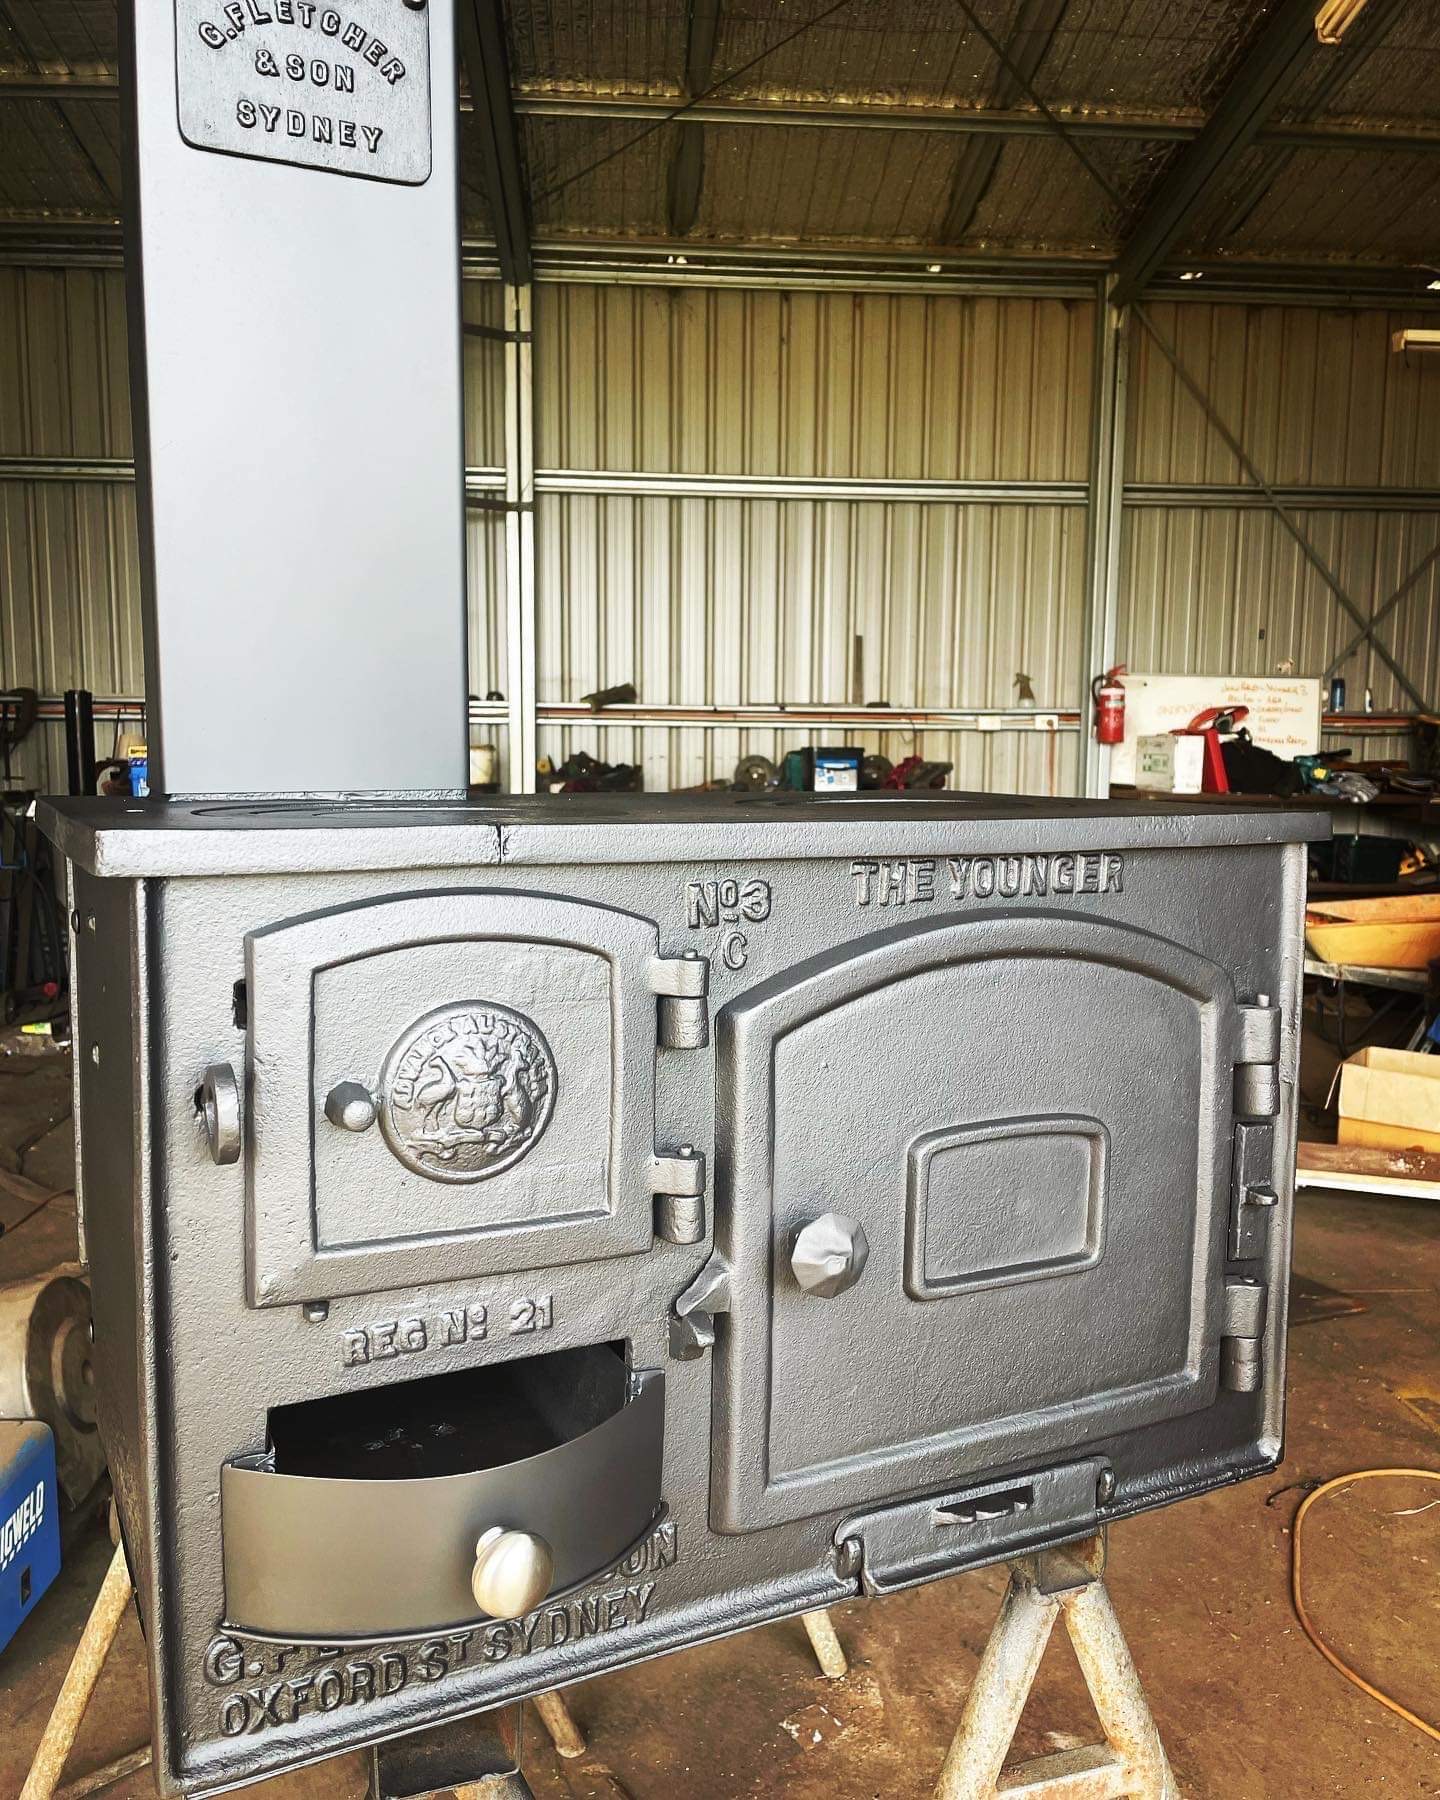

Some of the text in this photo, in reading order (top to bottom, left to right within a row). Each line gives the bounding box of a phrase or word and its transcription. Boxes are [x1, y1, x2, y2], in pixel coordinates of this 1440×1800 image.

[237, 100, 383, 152] SYDNEY
[851, 852, 1125, 907] THE YOUNGER
[723, 931, 748, 970] C
[339, 1317, 428, 1367] REG
[510, 1295, 553, 1335] 21
[598, 1521, 679, 1584] ON
[220, 1652, 408, 1738] OXFORD
[484, 1582, 656, 1662] SYDNEY
